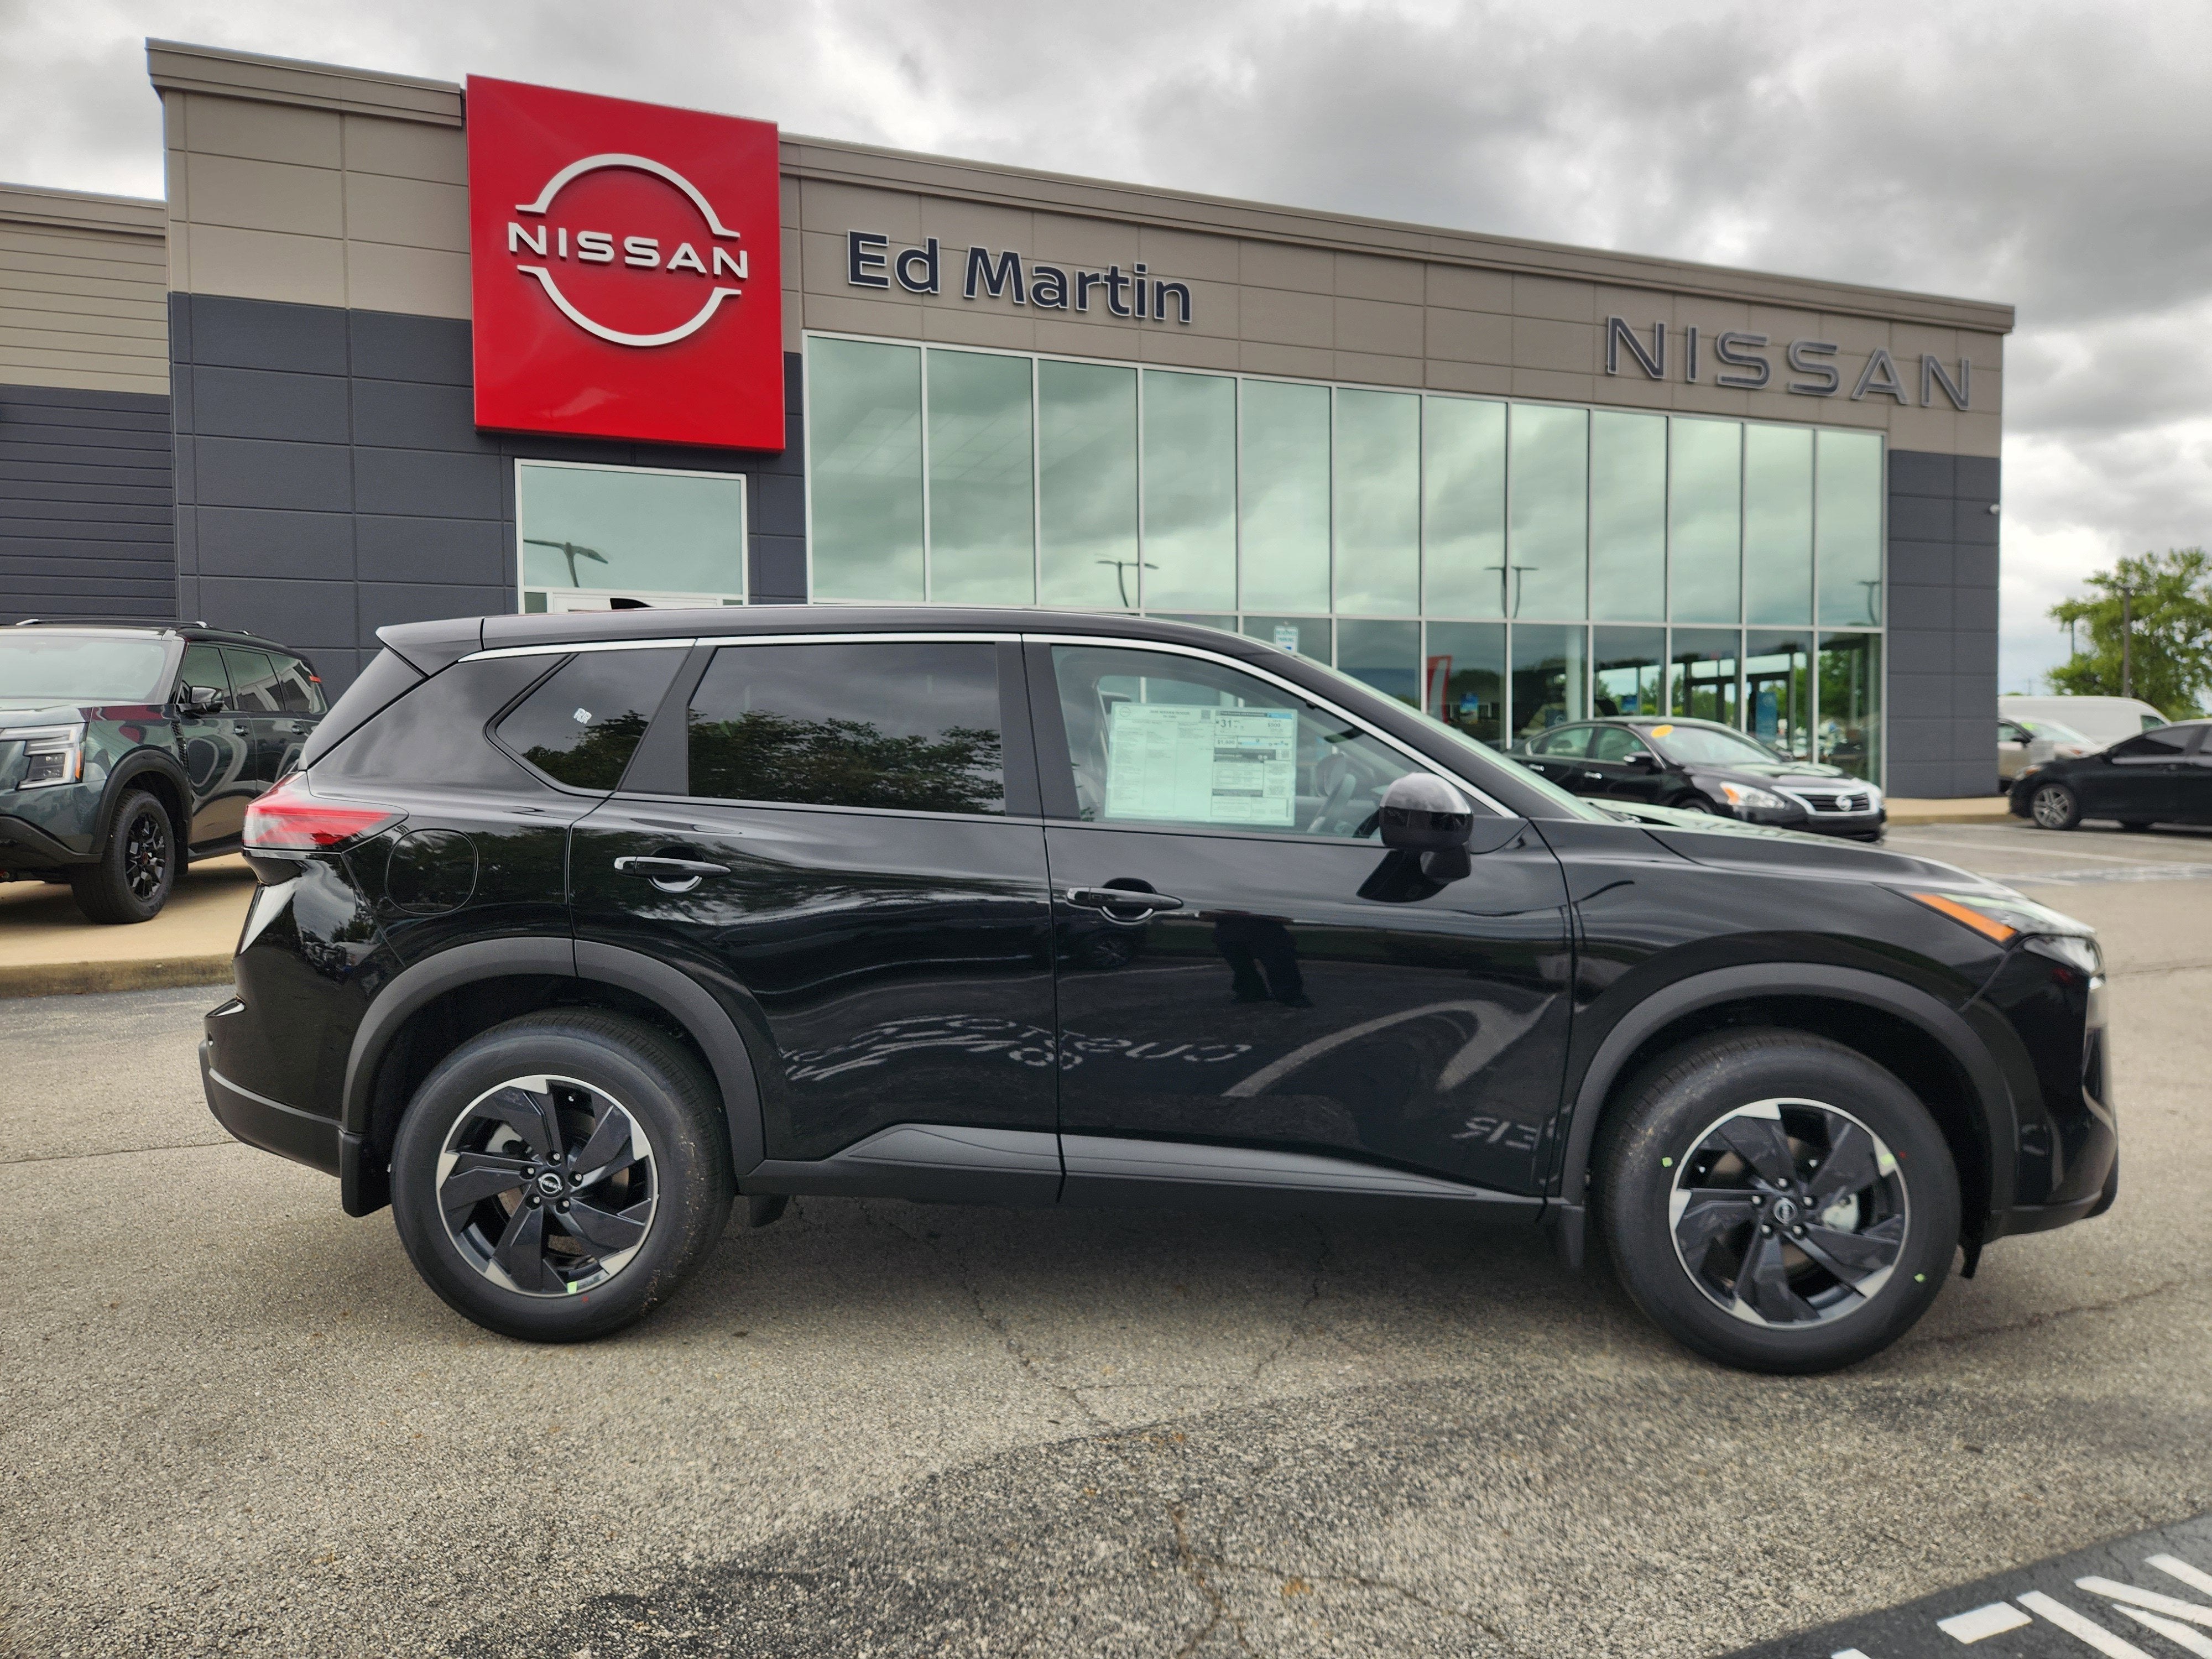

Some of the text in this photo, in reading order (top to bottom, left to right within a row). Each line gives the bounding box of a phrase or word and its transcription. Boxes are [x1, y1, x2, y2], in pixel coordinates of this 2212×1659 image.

[508, 222, 748, 279] NISSAN
[848, 229, 1192, 323] Ed Martin
[1606, 315, 1970, 411] NISSAN
[1220, 719, 1232, 728] 31
